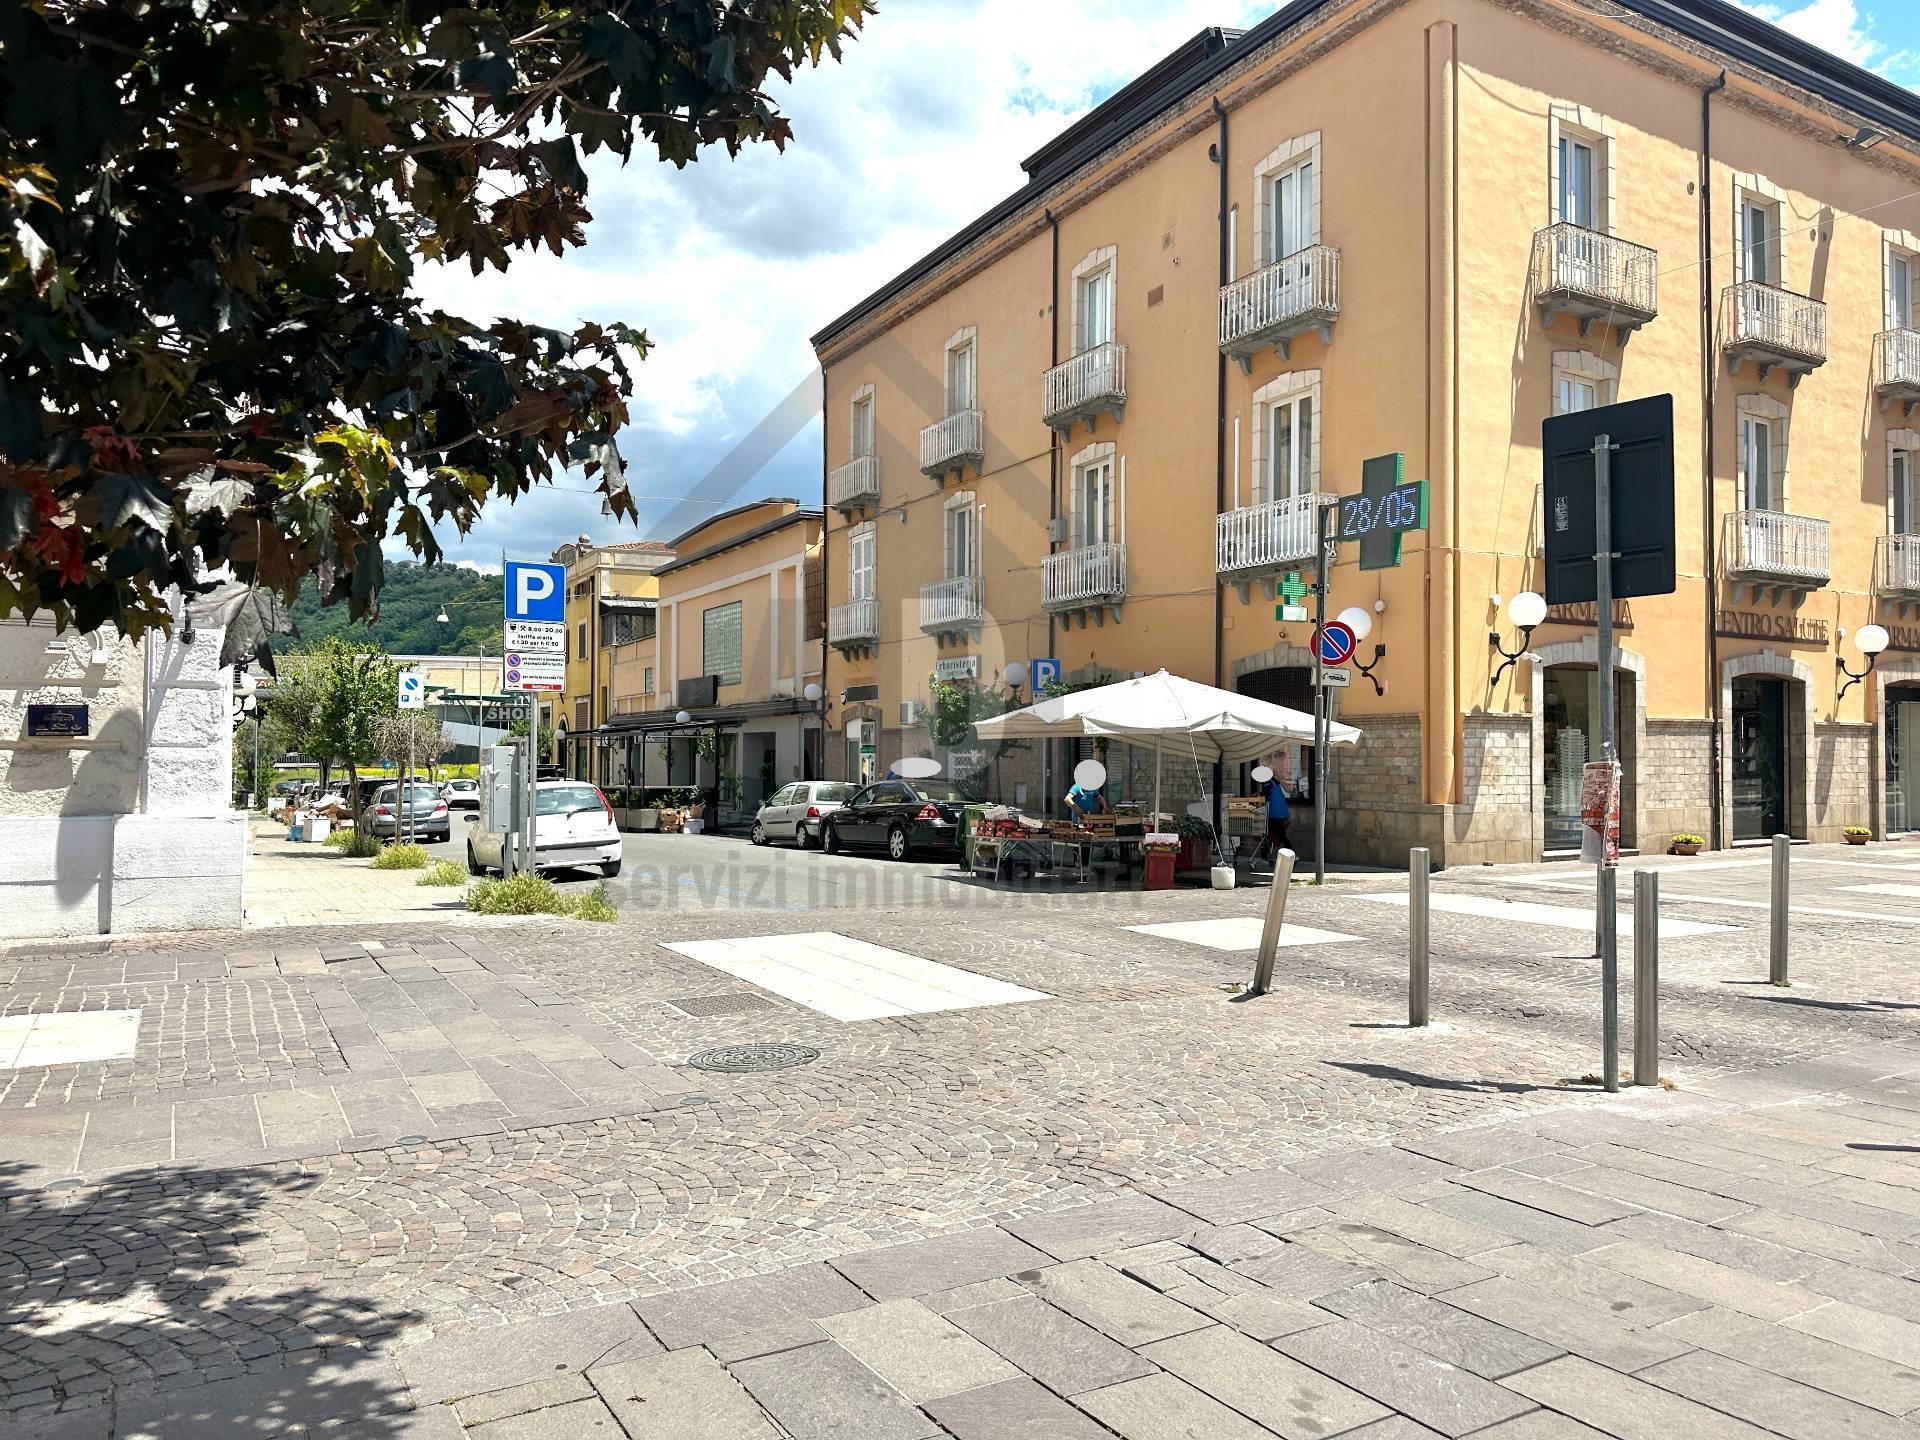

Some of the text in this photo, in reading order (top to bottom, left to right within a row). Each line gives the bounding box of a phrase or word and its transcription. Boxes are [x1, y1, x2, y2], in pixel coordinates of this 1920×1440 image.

[1343, 488, 1416, 535] 28/05
[517, 567, 554, 615] P
[1775, 615, 1828, 640] SALUTE
